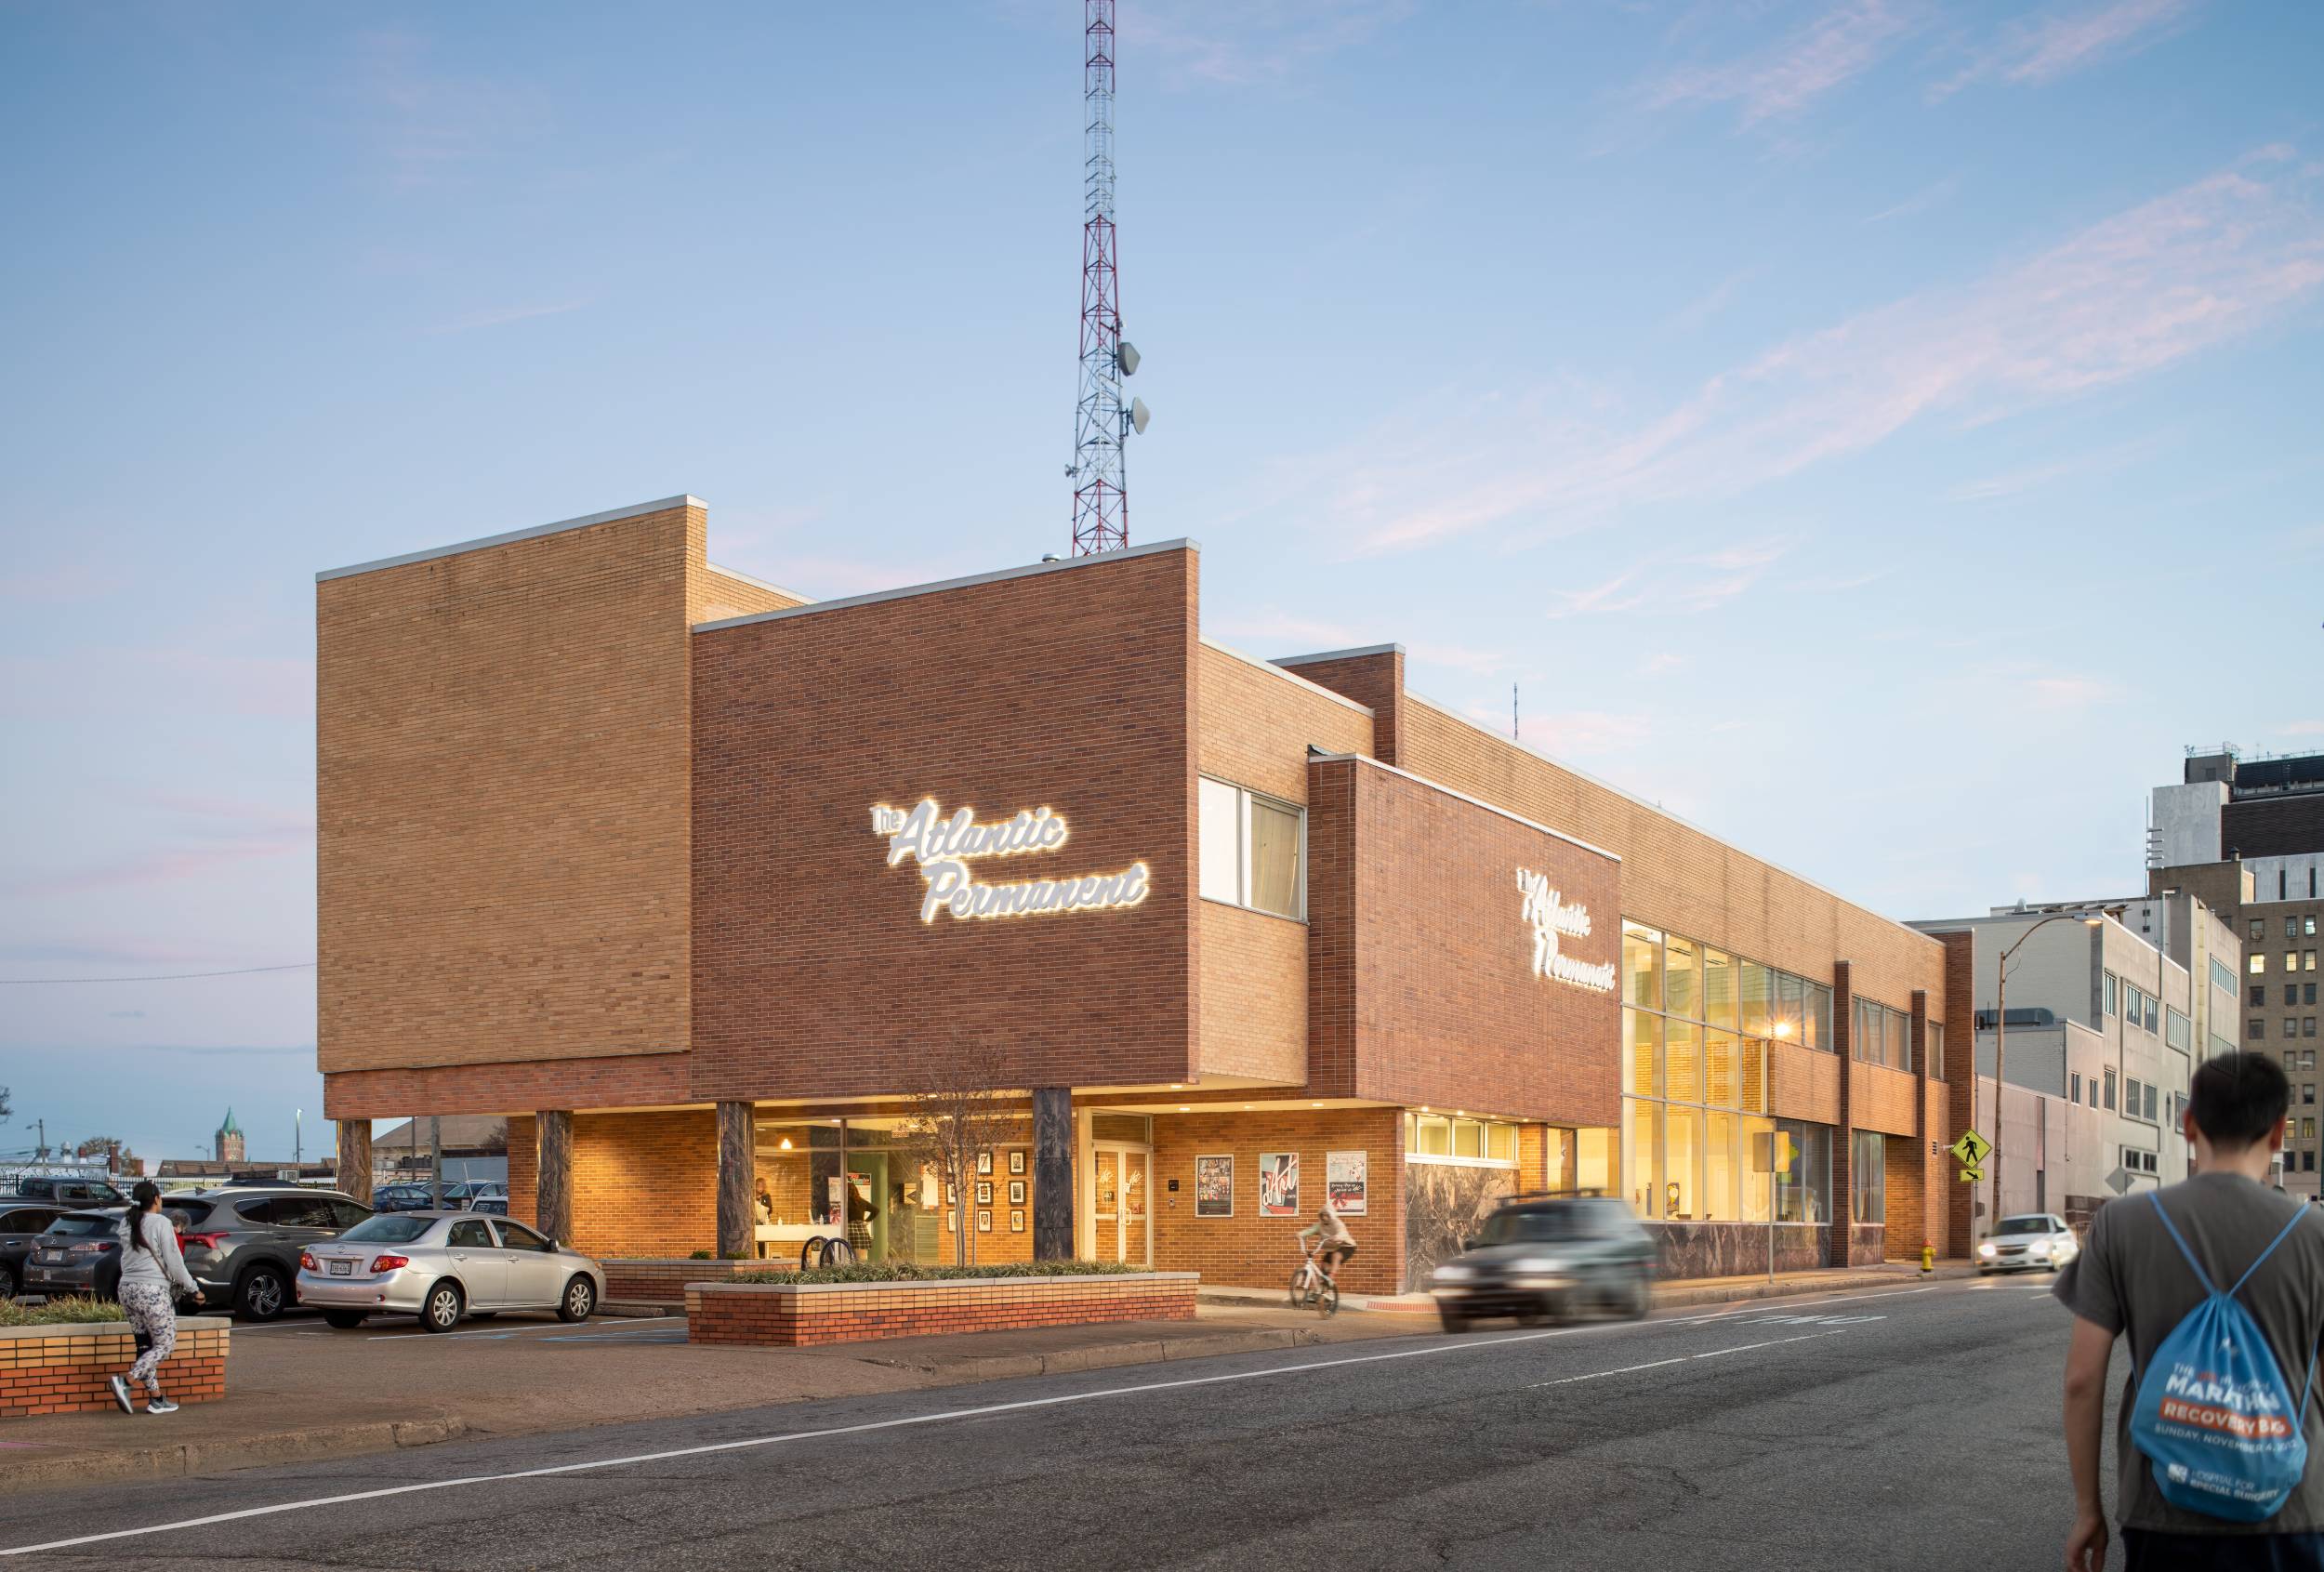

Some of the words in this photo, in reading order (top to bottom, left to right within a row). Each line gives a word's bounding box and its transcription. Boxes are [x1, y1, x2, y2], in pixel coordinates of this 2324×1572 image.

[870, 805, 904, 833] The
[887, 798, 1065, 865] Atlantic
[920, 861, 1149, 921] Permanent
[2164, 1402, 2256, 1433] RECOVERY
[2203, 1434, 2263, 1453] NOVEMBER
